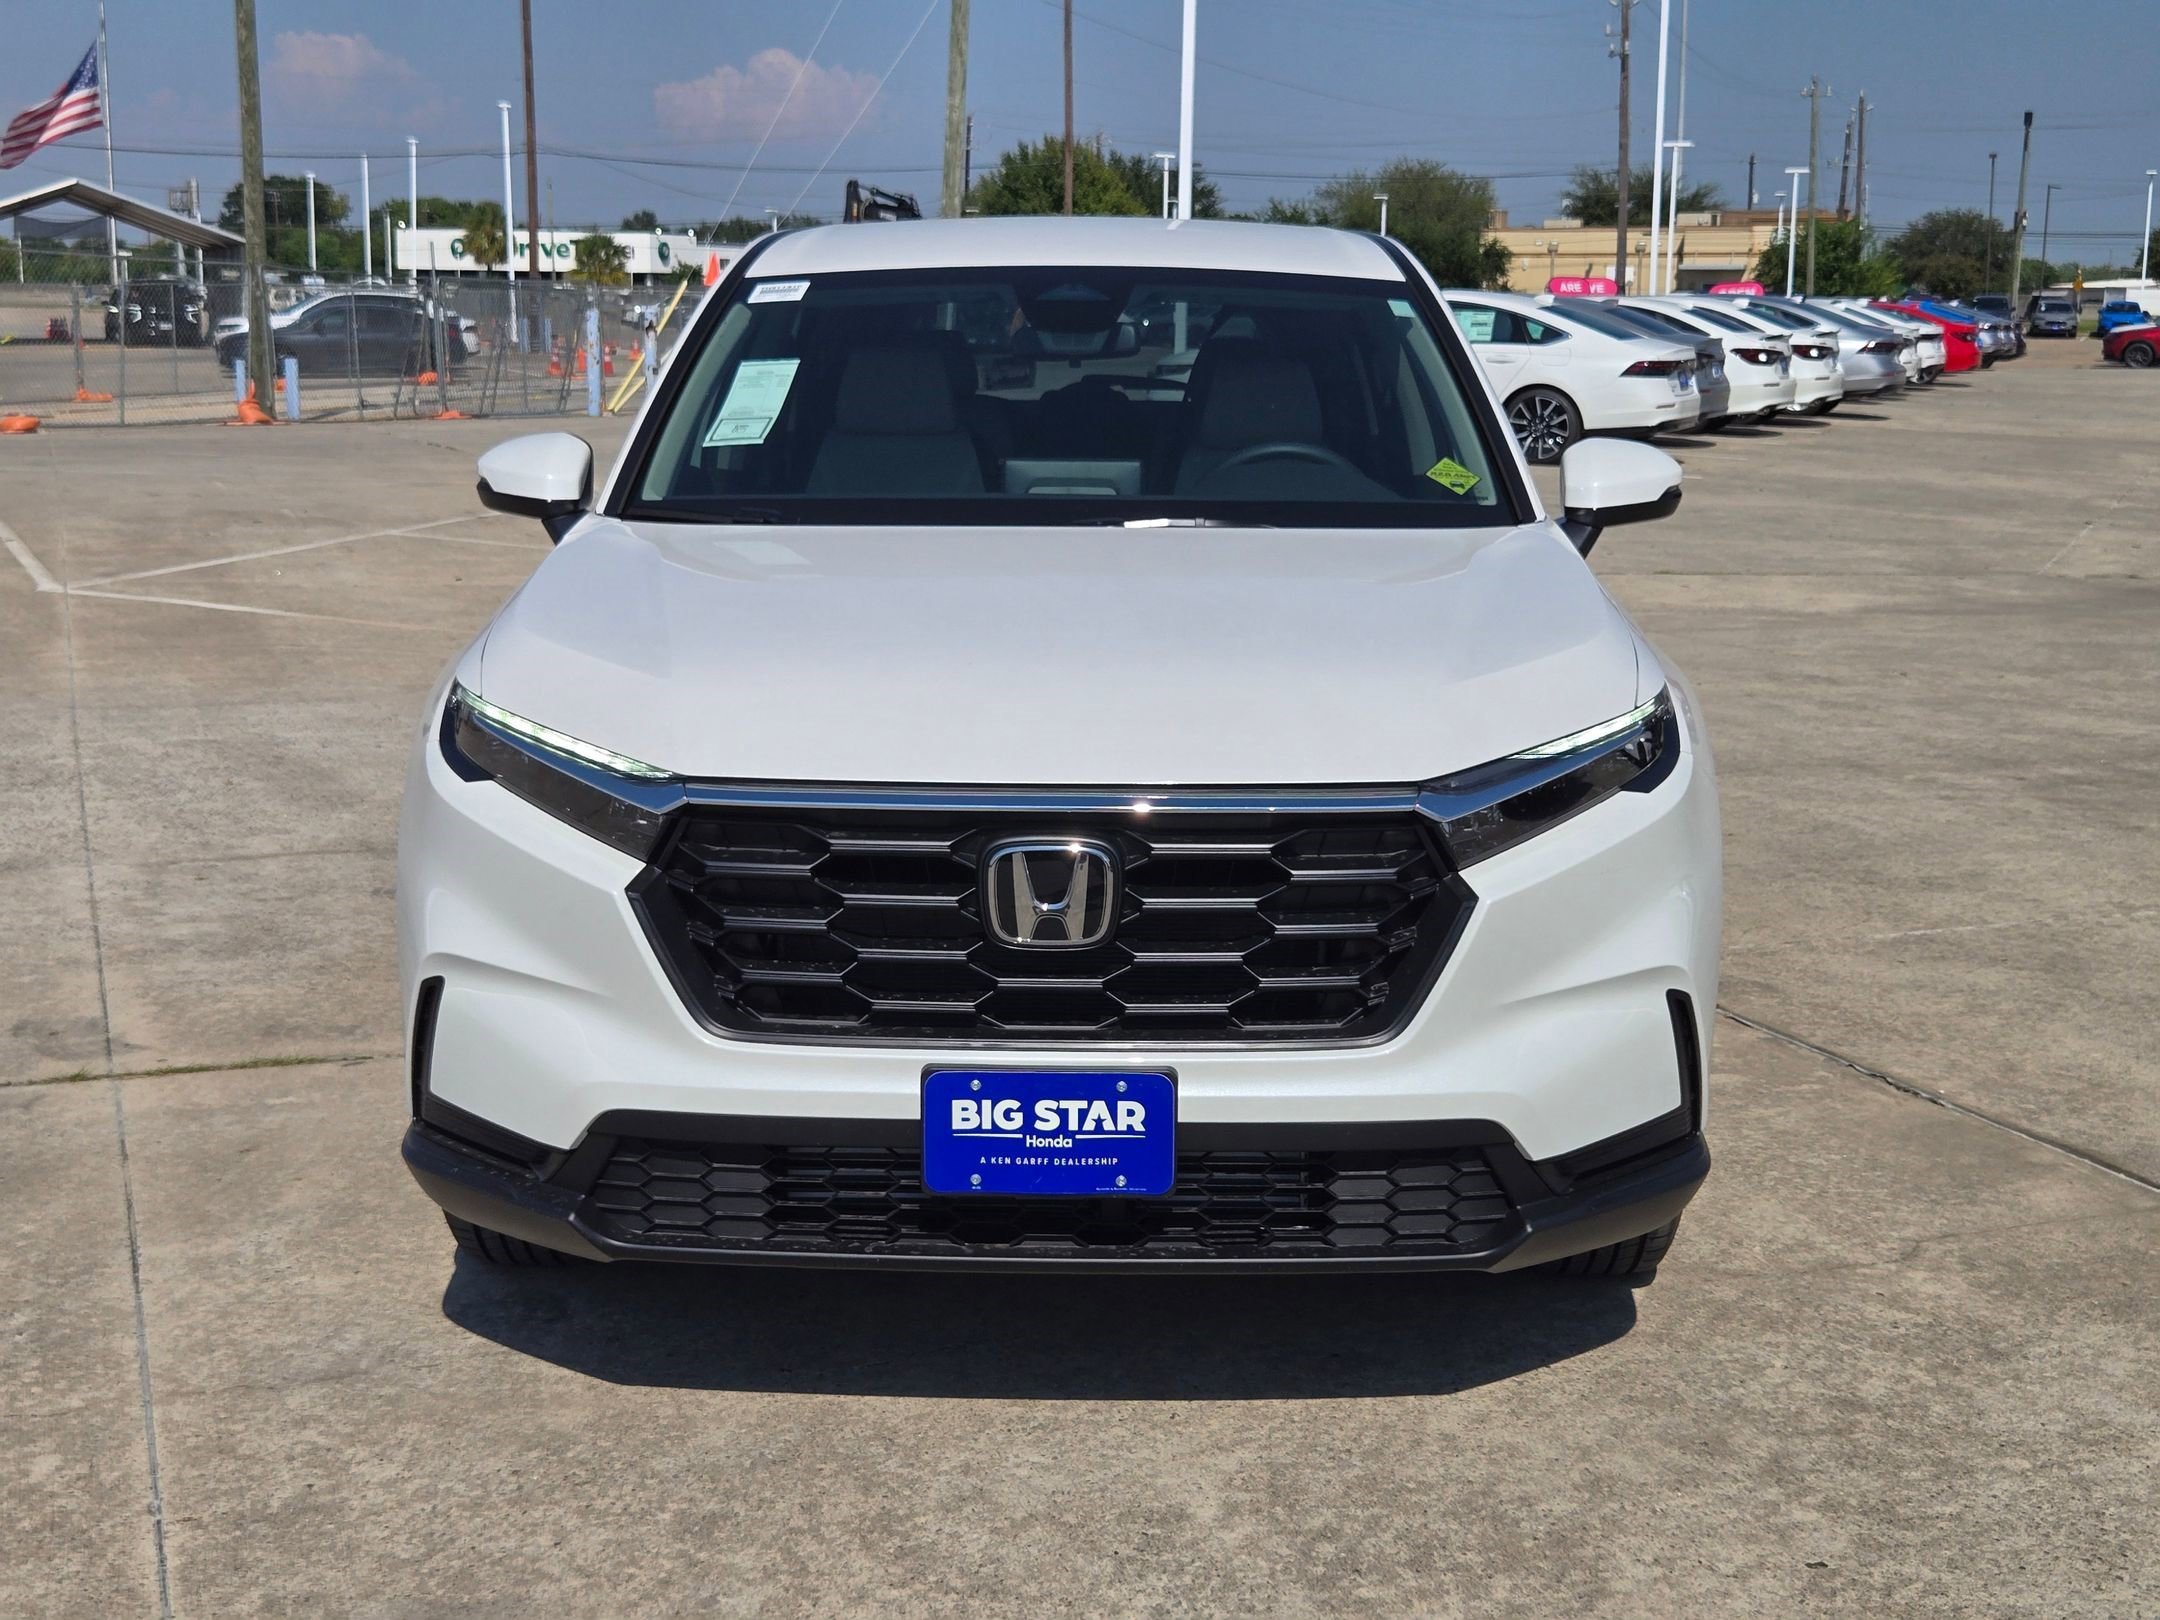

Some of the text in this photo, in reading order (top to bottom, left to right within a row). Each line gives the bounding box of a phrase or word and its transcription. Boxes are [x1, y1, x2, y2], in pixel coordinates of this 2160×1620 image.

[1560, 281, 1582, 293] ARE
[952, 1099, 1146, 1131] BIG STAR
[1026, 1134, 1073, 1148] Honda
[991, 1157, 1011, 1165] KEN
[1015, 1157, 1049, 1165] GARFF
[1054, 1158, 1118, 1166] DEALERSHIP
